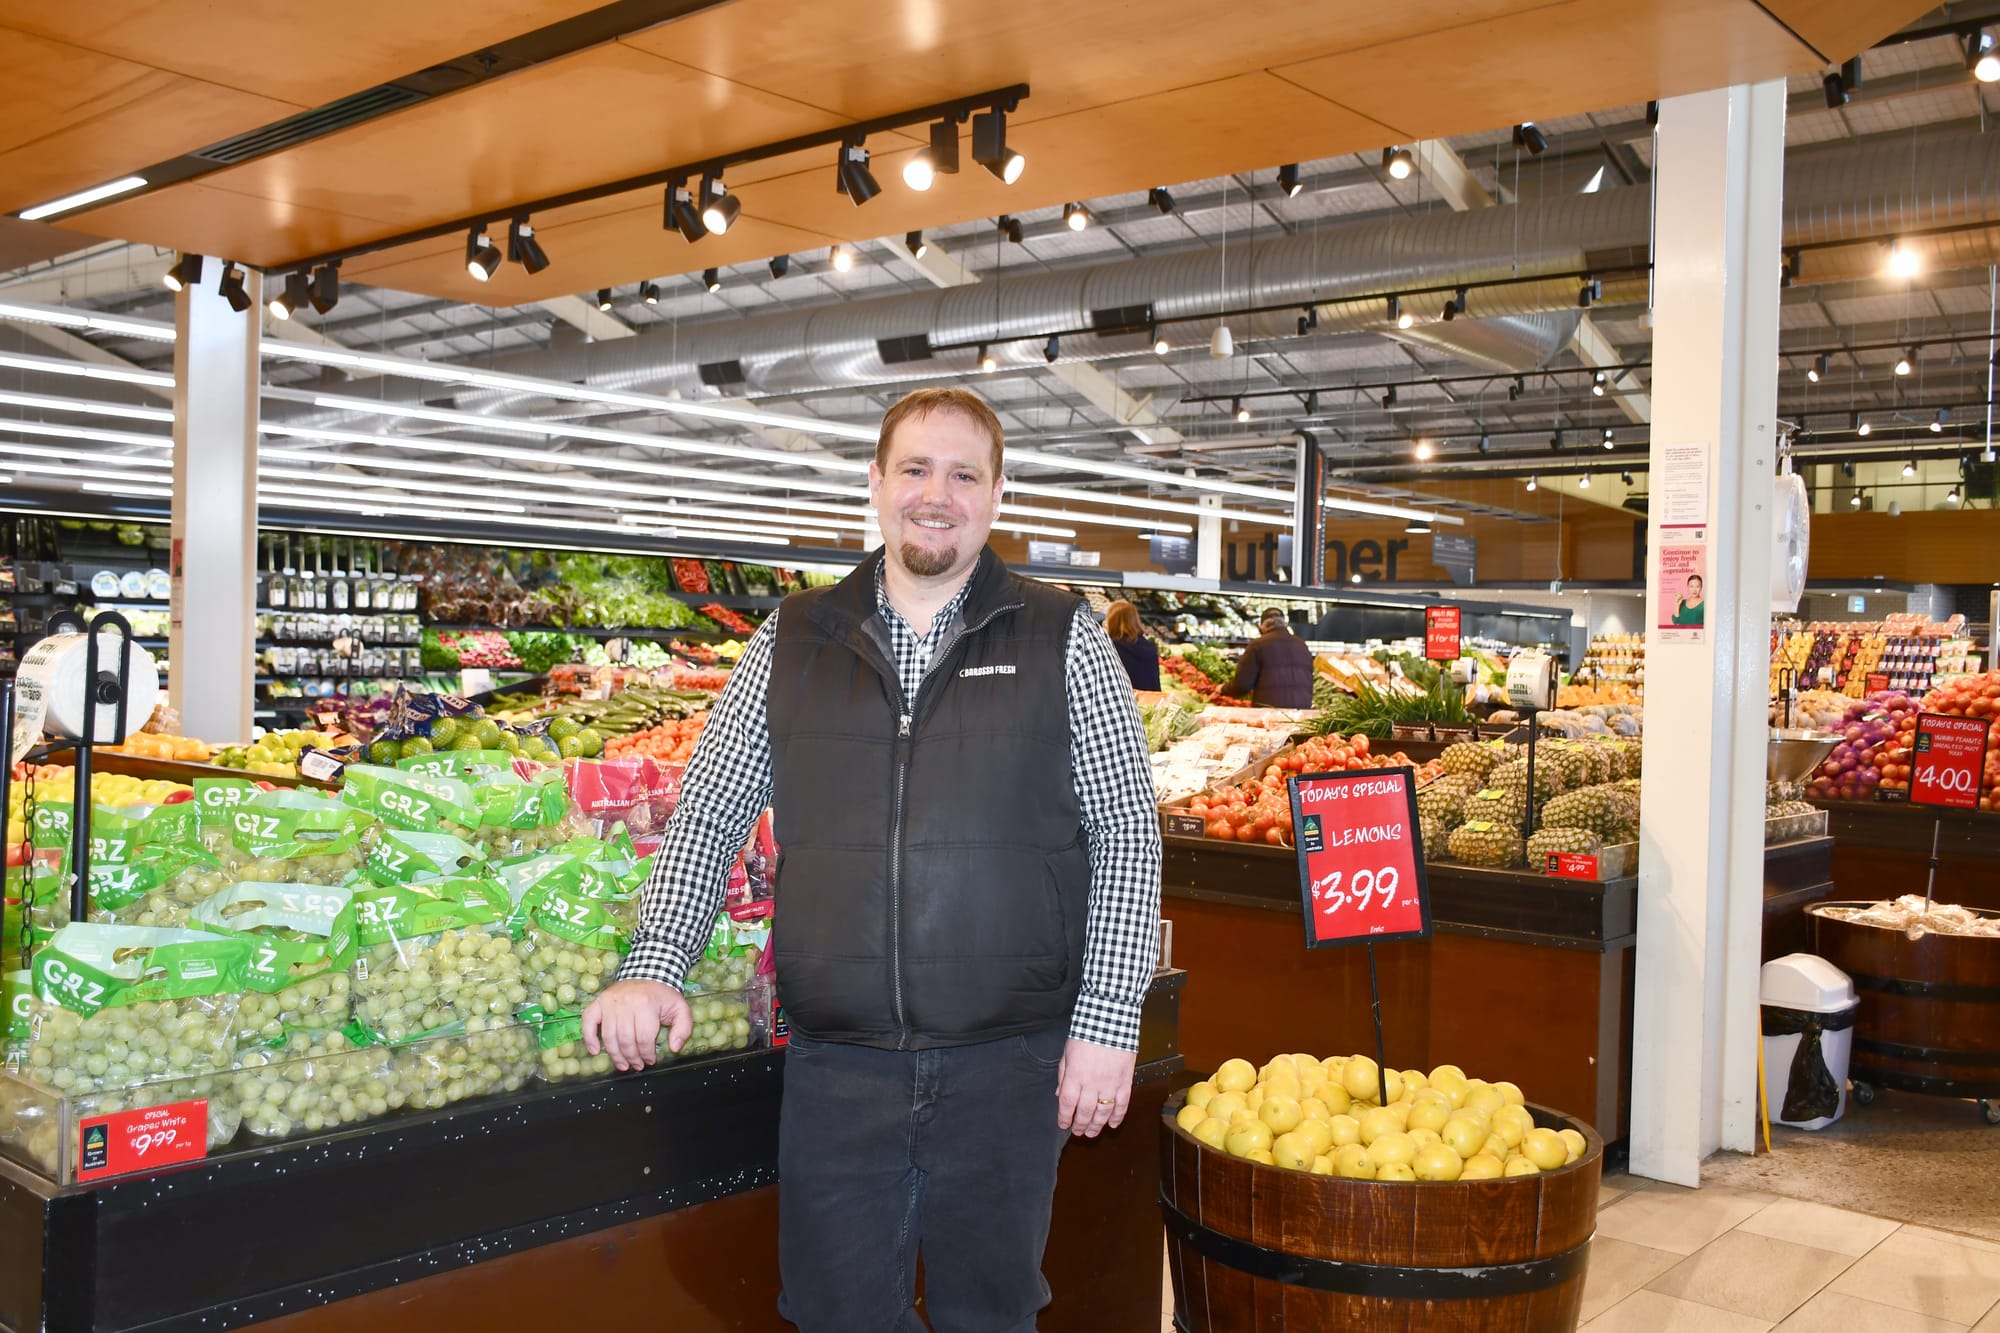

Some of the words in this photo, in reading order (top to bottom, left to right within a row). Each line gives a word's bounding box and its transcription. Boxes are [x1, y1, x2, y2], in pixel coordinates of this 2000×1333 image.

[995, 664, 1016, 675] FRESH
[1914, 765, 1971, 792] $4.00
[1300, 784, 1349, 804] TODAY'S
[1352, 780, 1402, 798] SPECIAL
[380, 790, 431, 822] GRZ
[35, 808, 69, 830] GR
[1332, 824, 1402, 847] LEMONS
[1311, 866, 1399, 915] $3.99
[43, 959, 105, 1007] GRZ
[126, 1121, 161, 1134] Grapes
[161, 1116, 187, 1128] White
[130, 1129, 177, 1156] $9.99
